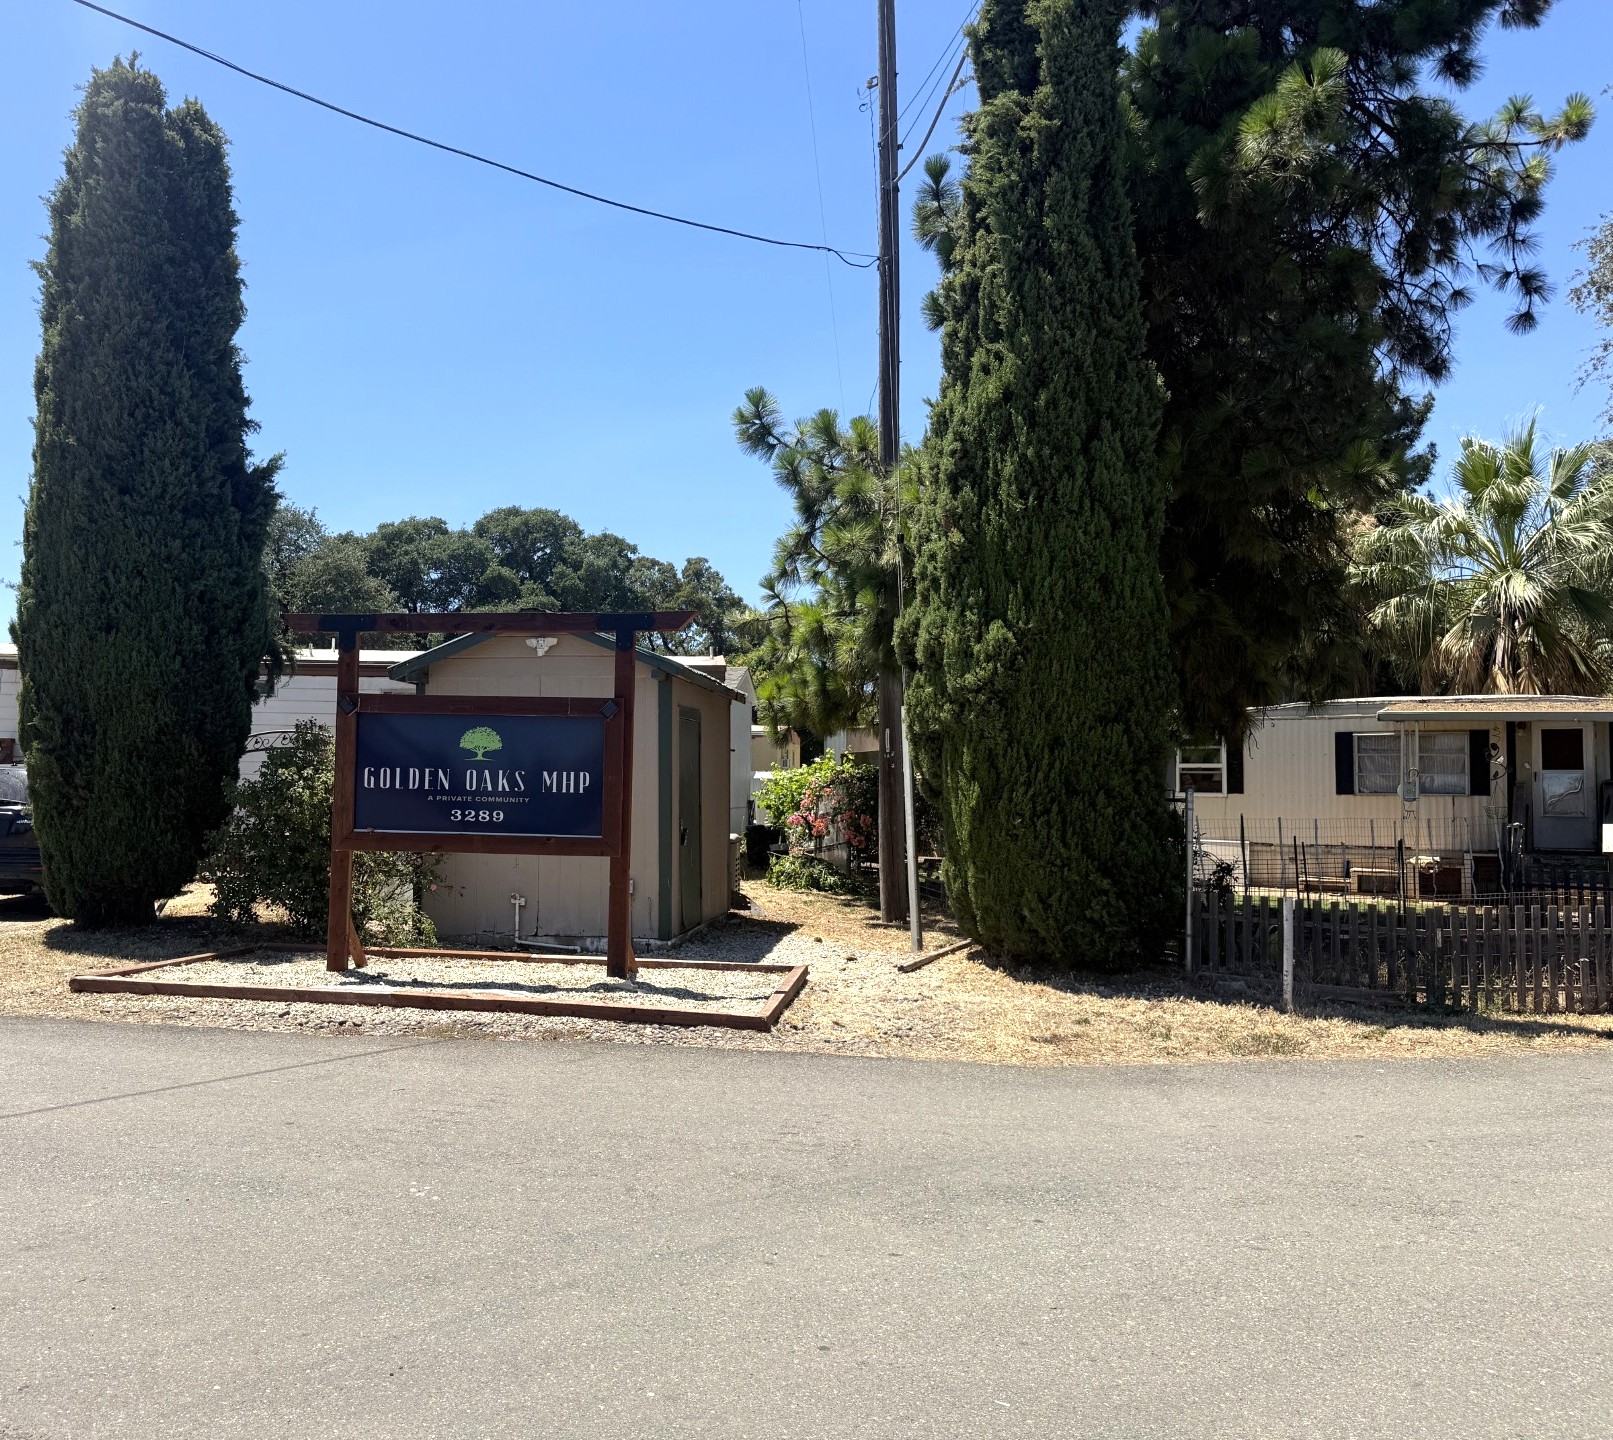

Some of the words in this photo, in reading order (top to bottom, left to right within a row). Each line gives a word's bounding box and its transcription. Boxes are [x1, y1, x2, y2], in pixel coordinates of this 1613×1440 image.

[363, 766, 450, 790] GOLDEN
[465, 769, 525, 792] OAKS
[541, 770, 591, 794] MHP
[450, 809, 505, 822] 3289
